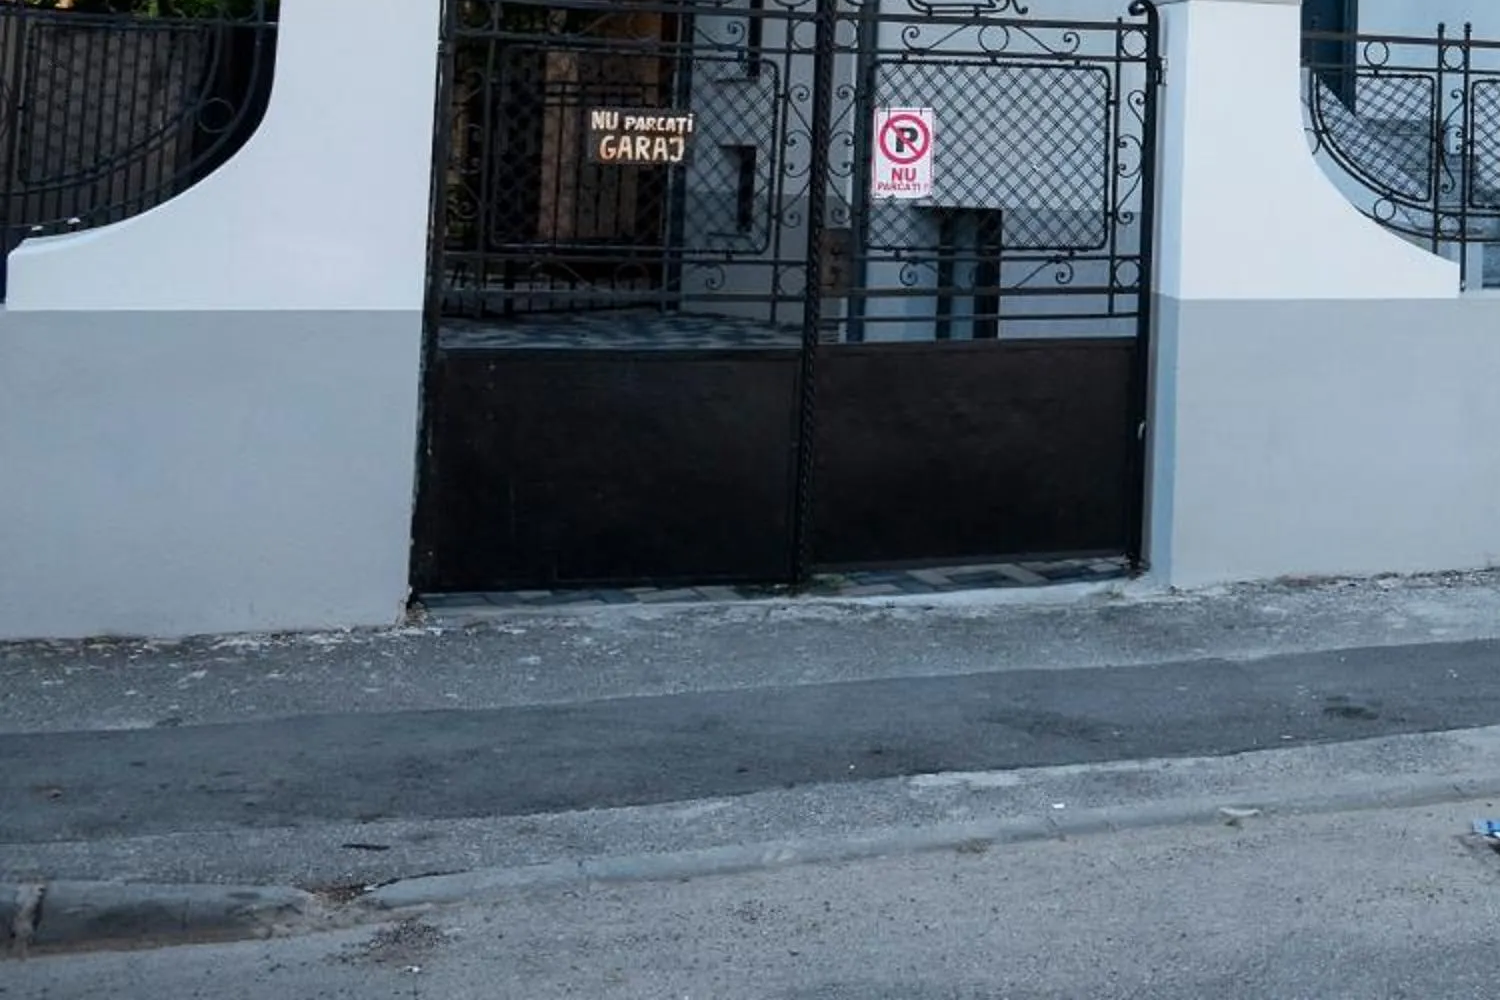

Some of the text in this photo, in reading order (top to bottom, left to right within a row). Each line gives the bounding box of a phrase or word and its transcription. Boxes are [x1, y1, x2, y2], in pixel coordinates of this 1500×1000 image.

[591, 110, 619, 130] NU
[599, 135, 685, 162] GARAJ
[892, 167, 917, 183] NU
